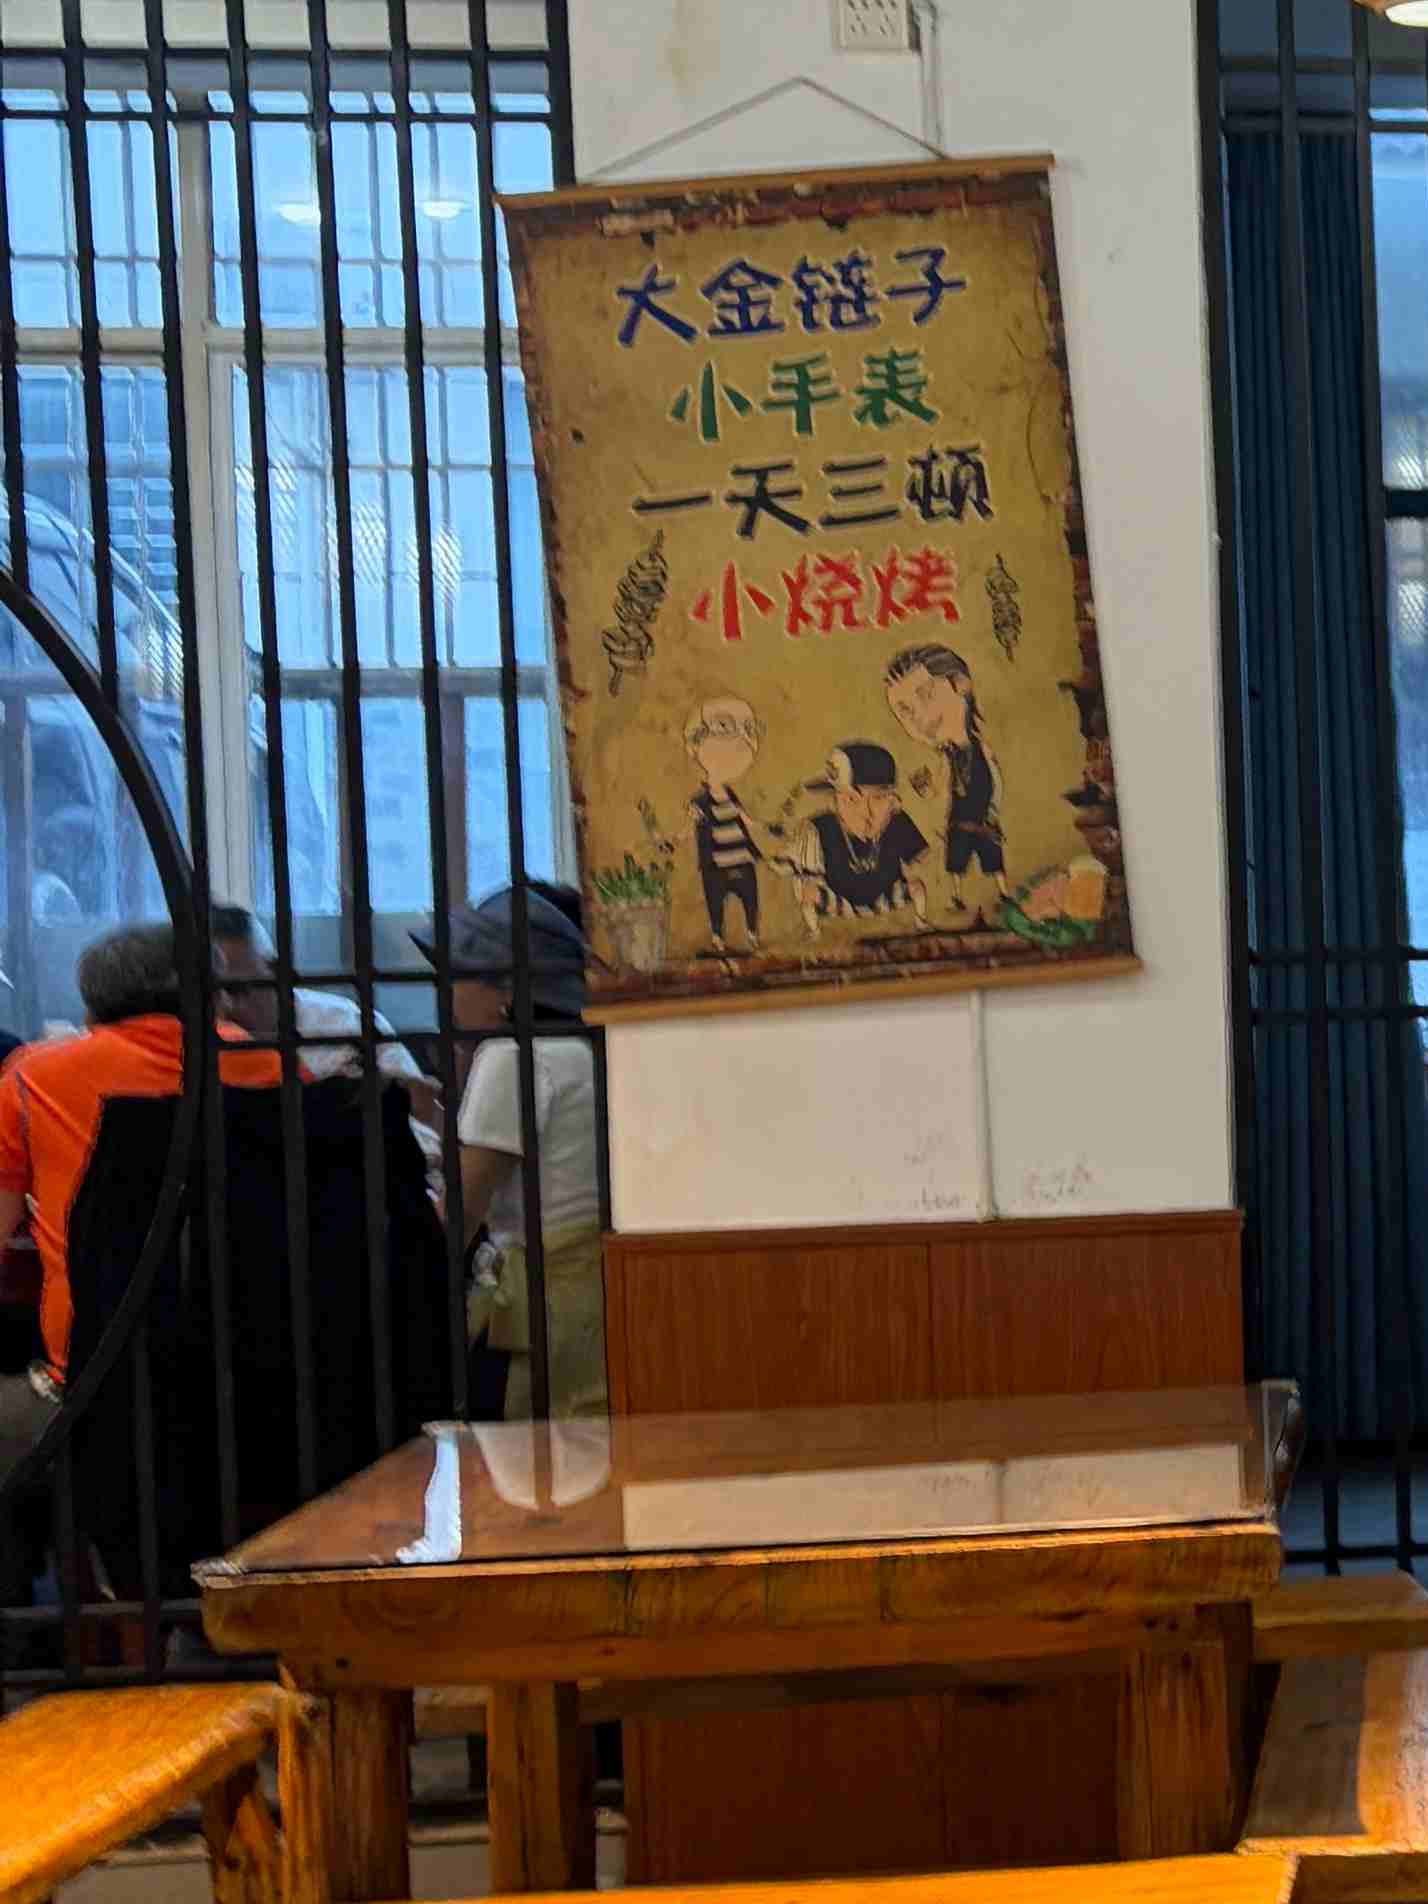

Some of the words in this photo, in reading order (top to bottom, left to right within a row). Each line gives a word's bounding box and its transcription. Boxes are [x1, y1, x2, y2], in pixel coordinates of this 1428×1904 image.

[615, 248, 967, 347] 大金链子
[669, 349, 938, 441] 小手表
[632, 446, 992, 540] 一天三顿
[690, 549, 960, 640] 小烧烤
